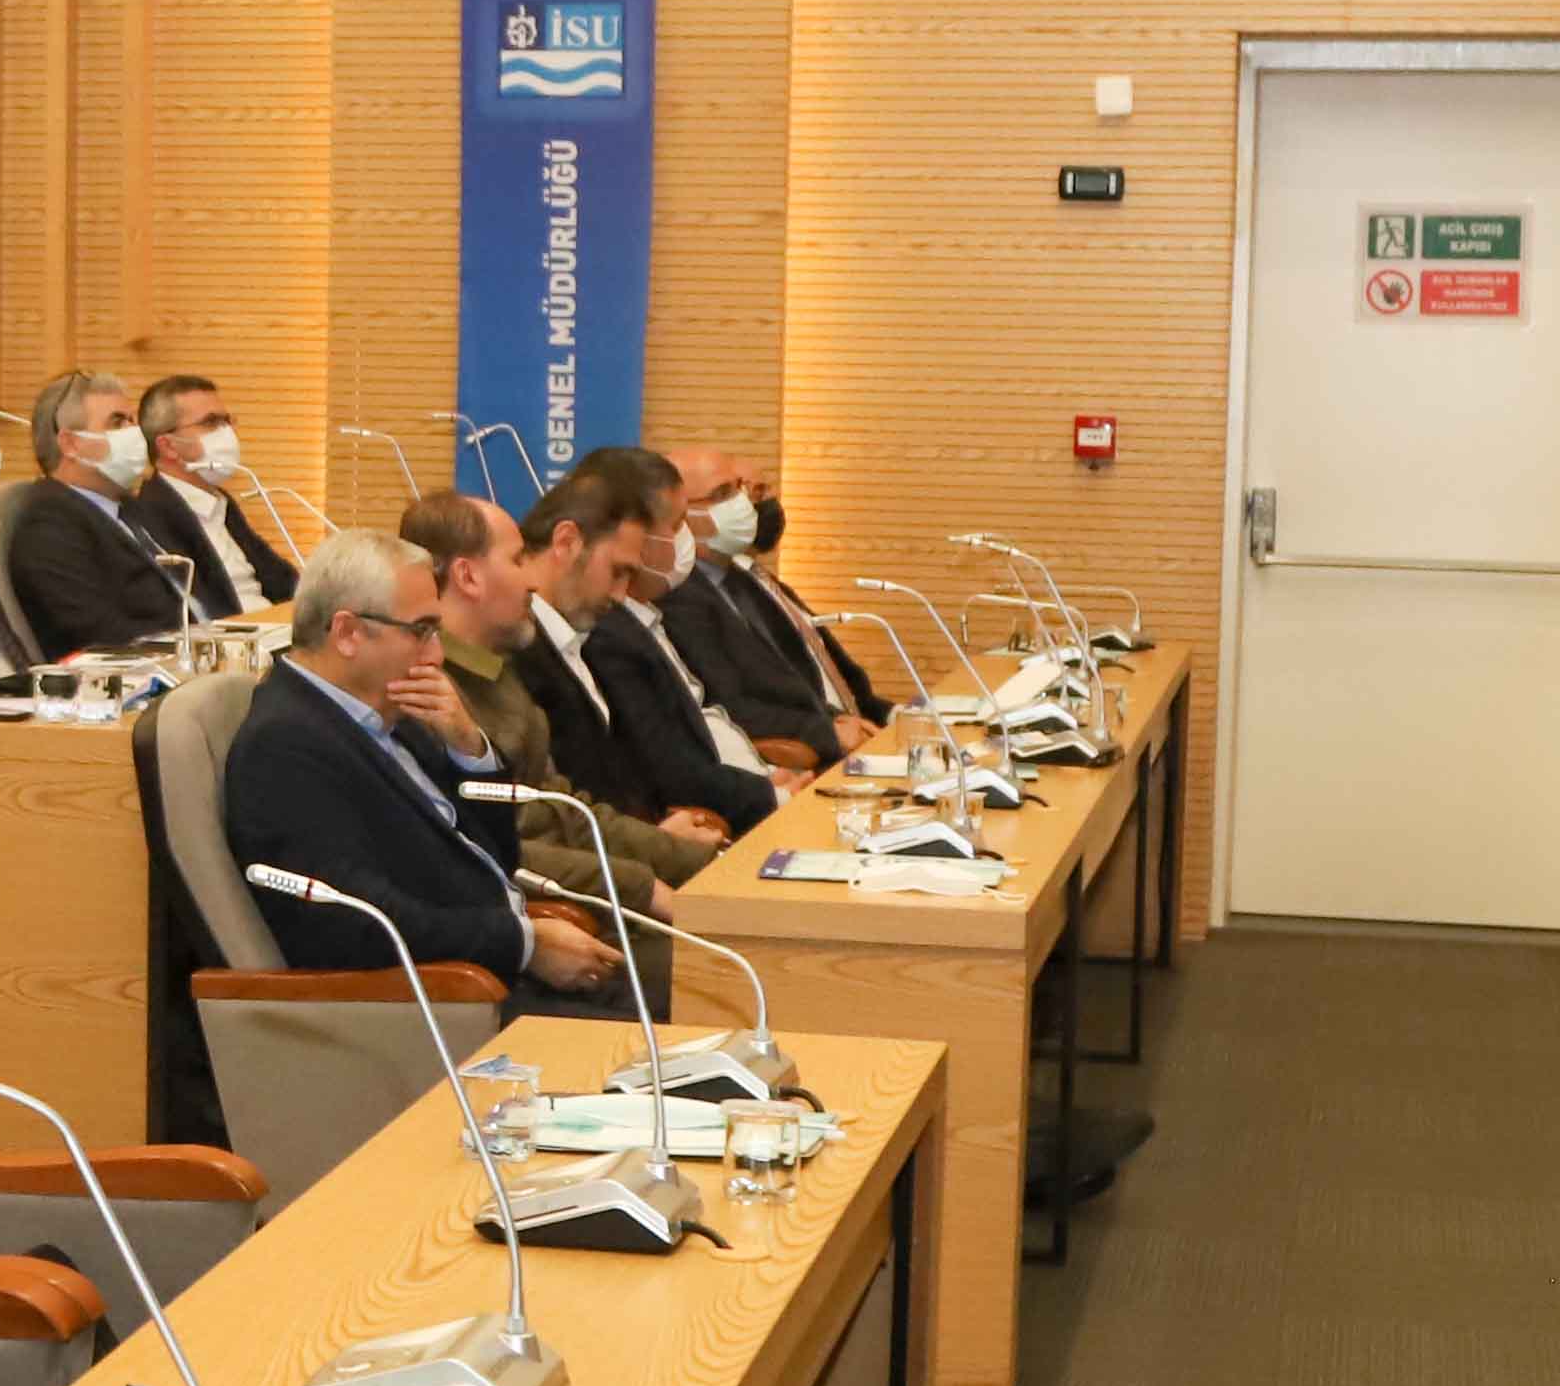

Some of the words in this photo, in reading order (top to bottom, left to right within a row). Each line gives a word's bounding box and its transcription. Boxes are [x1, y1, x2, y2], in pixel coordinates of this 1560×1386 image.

[551, 9, 620, 46] İSU
[541, 139, 578, 346] MÜDÜRLÜĞÜ
[546, 354, 576, 462] GENEL
